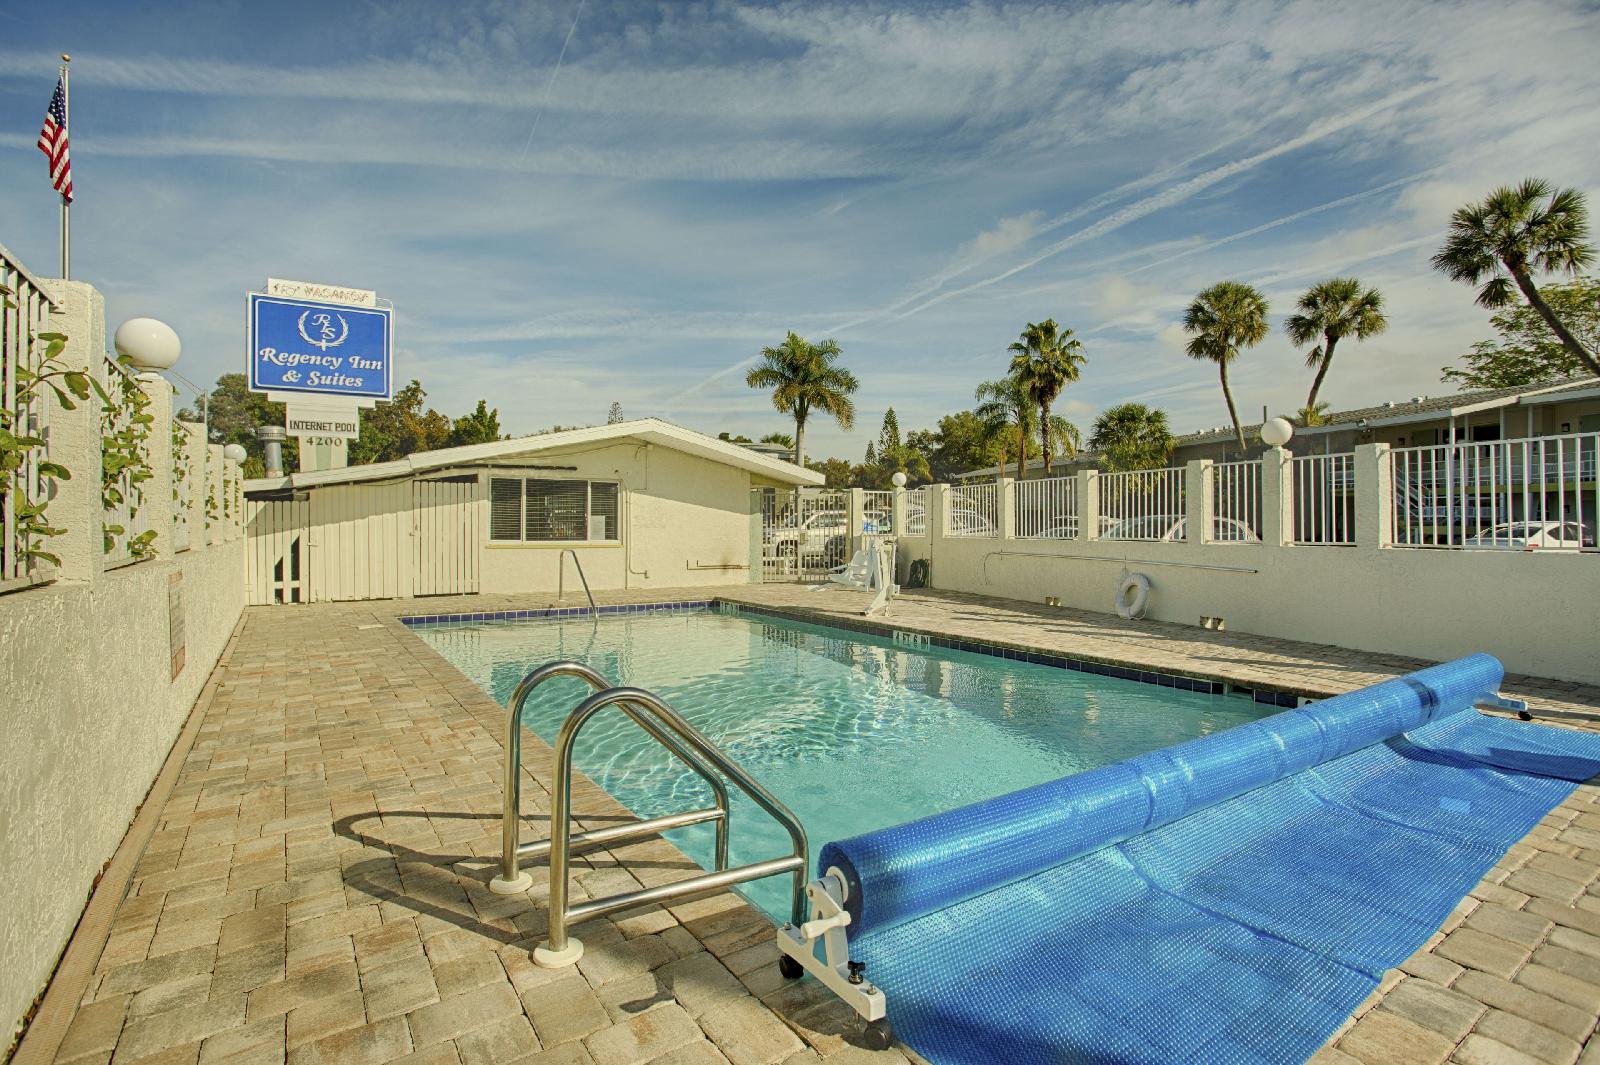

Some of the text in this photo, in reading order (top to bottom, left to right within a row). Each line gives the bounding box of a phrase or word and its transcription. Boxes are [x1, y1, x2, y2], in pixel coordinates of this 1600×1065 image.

[259, 347, 384, 370] Regency Inn
[282, 369, 364, 388] & Suites
[289, 419, 333, 431] INTERNET
[306, 436, 343, 447] 4200
